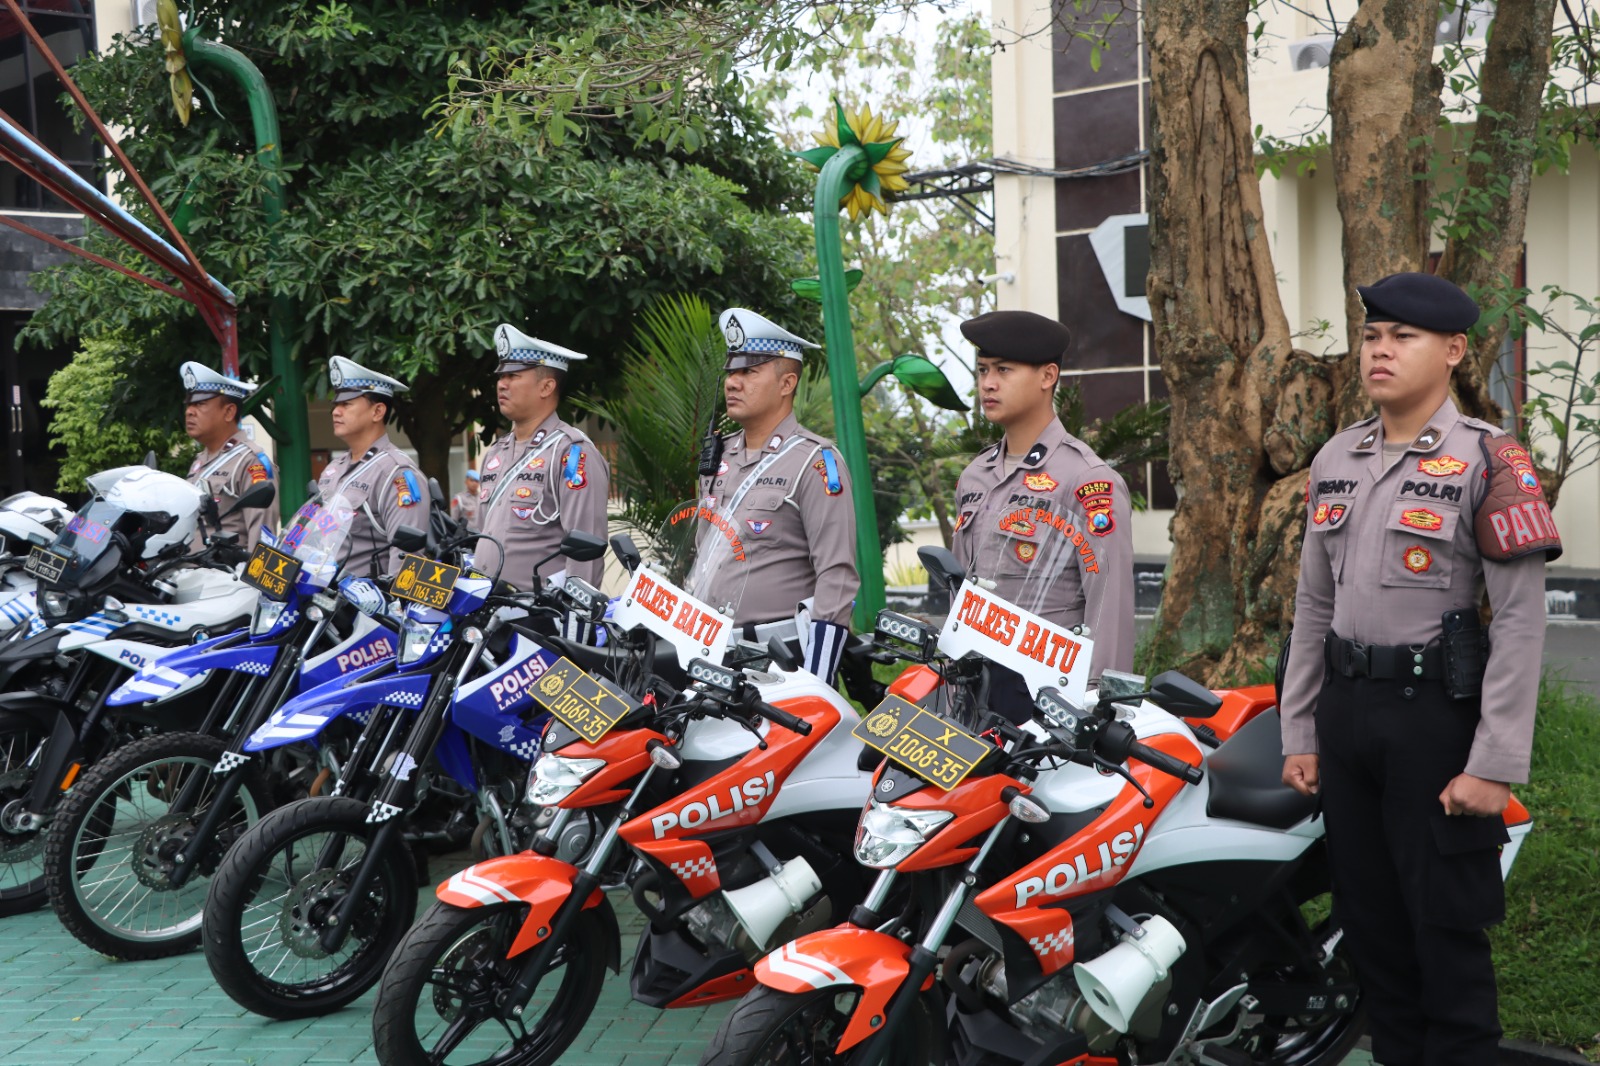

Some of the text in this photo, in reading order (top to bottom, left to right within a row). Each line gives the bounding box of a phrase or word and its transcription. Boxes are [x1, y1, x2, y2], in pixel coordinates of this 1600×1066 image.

[517, 473, 545, 482] POLRI
[756, 478, 787, 487] POLRI
[1008, 494, 1051, 512] POLRI
[1401, 480, 1463, 502] POLRI
[284, 524, 310, 550] 04
[671, 507, 746, 562] UNIT PAMOBVIT
[1000, 508, 1100, 574] UNIT PAMOBVIT
[48, 556, 57, 566] X
[274, 559, 288, 575] X
[260, 573, 286, 595] 1164-35
[429, 566, 447, 583] X
[631, 573, 725, 647] POLRES BATU
[957, 591, 1082, 674] POLRES BATU
[337, 638, 393, 672] POLISI
[490, 654, 549, 702] POLISI
[498, 691, 523, 711] LALU
[590, 689, 608, 706] X
[554, 694, 608, 737] 1069-35
[935, 728, 957, 746] X
[889, 732, 964, 784] 1068-35
[651, 770, 775, 839] POLISI
[1014, 822, 1144, 909] POLISI
